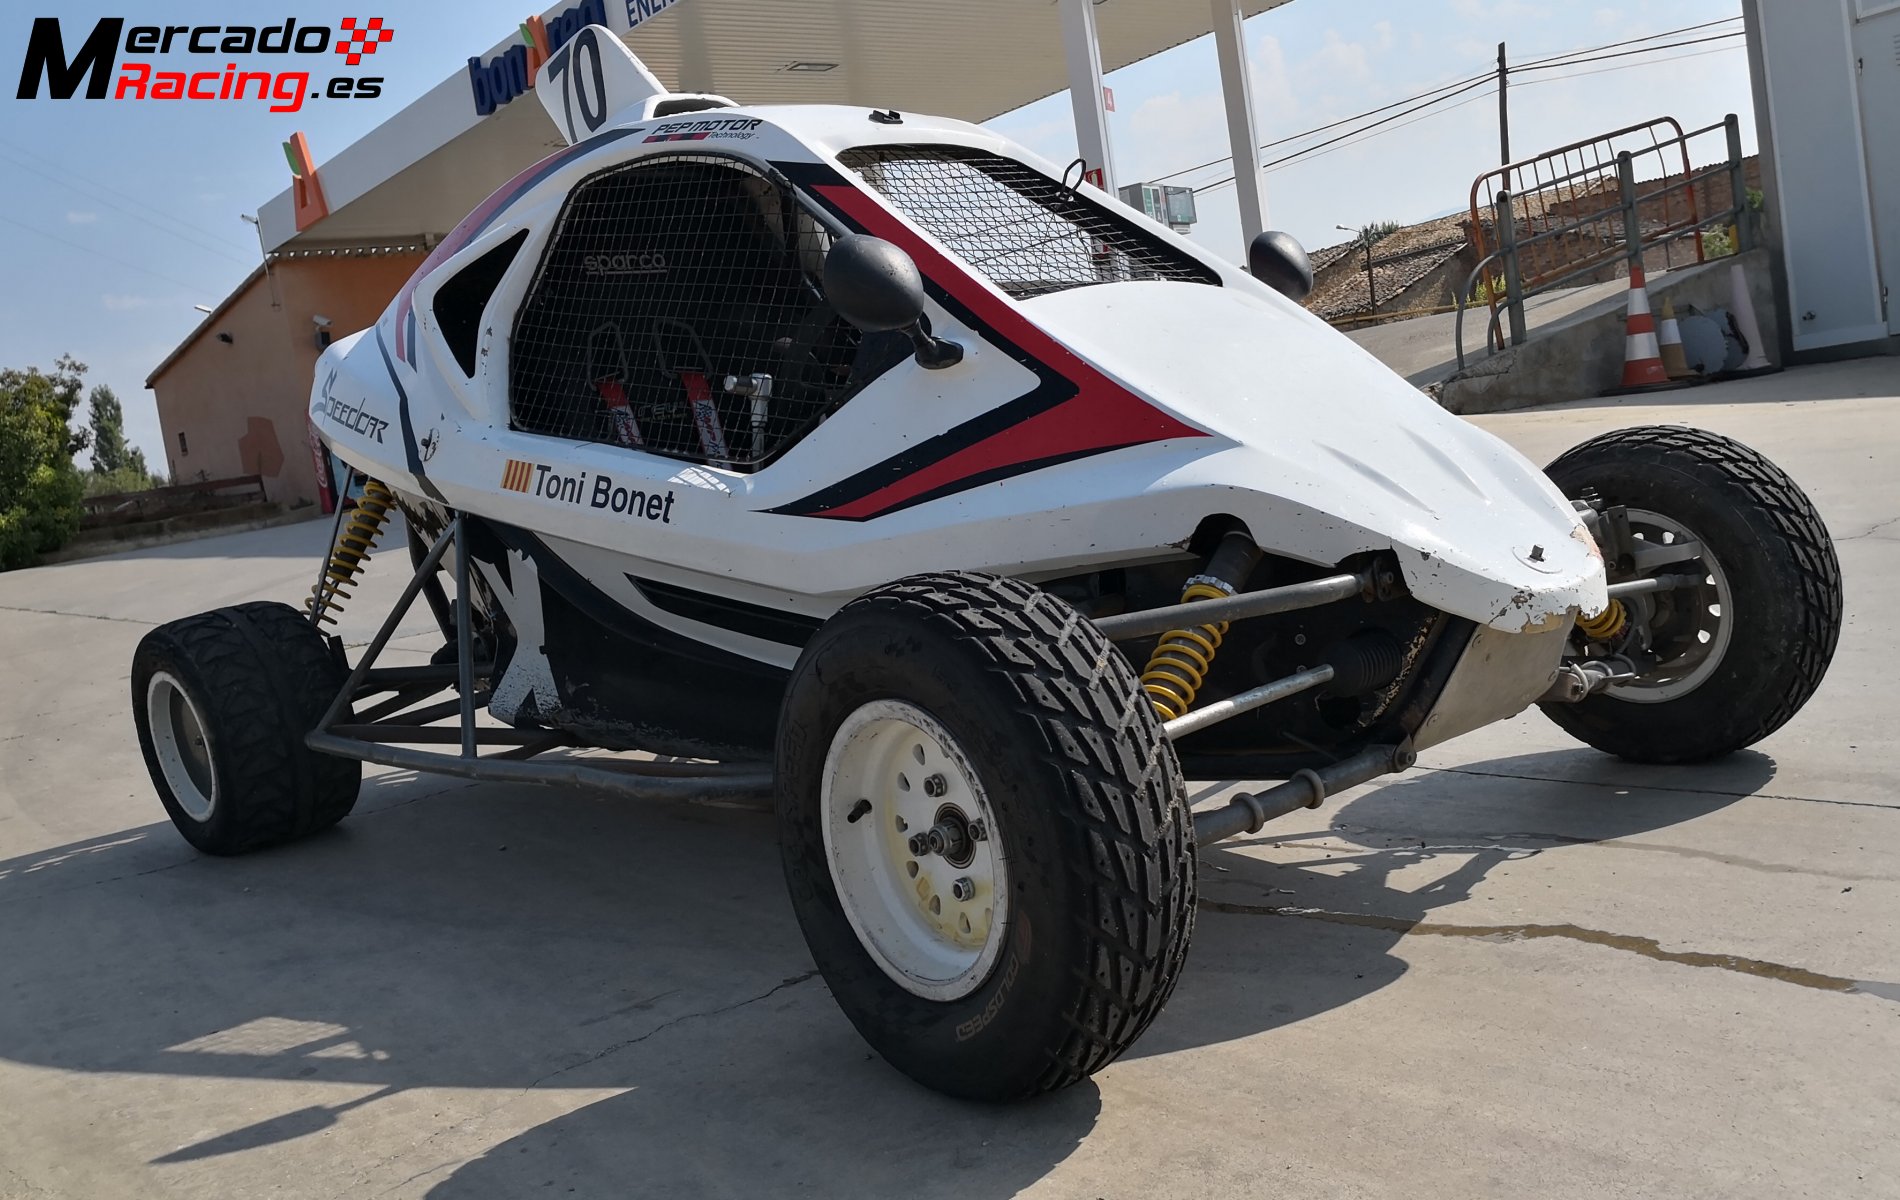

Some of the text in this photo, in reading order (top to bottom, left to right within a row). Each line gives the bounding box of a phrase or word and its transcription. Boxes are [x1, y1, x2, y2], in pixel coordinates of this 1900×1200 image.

[547, 28, 607, 145] 70
[652, 119, 763, 134] PEPMOTOR
[707, 131, 756, 140] Technology
[584, 253, 666, 276] sparco
[535, 464, 675, 523] Toni Bonet
